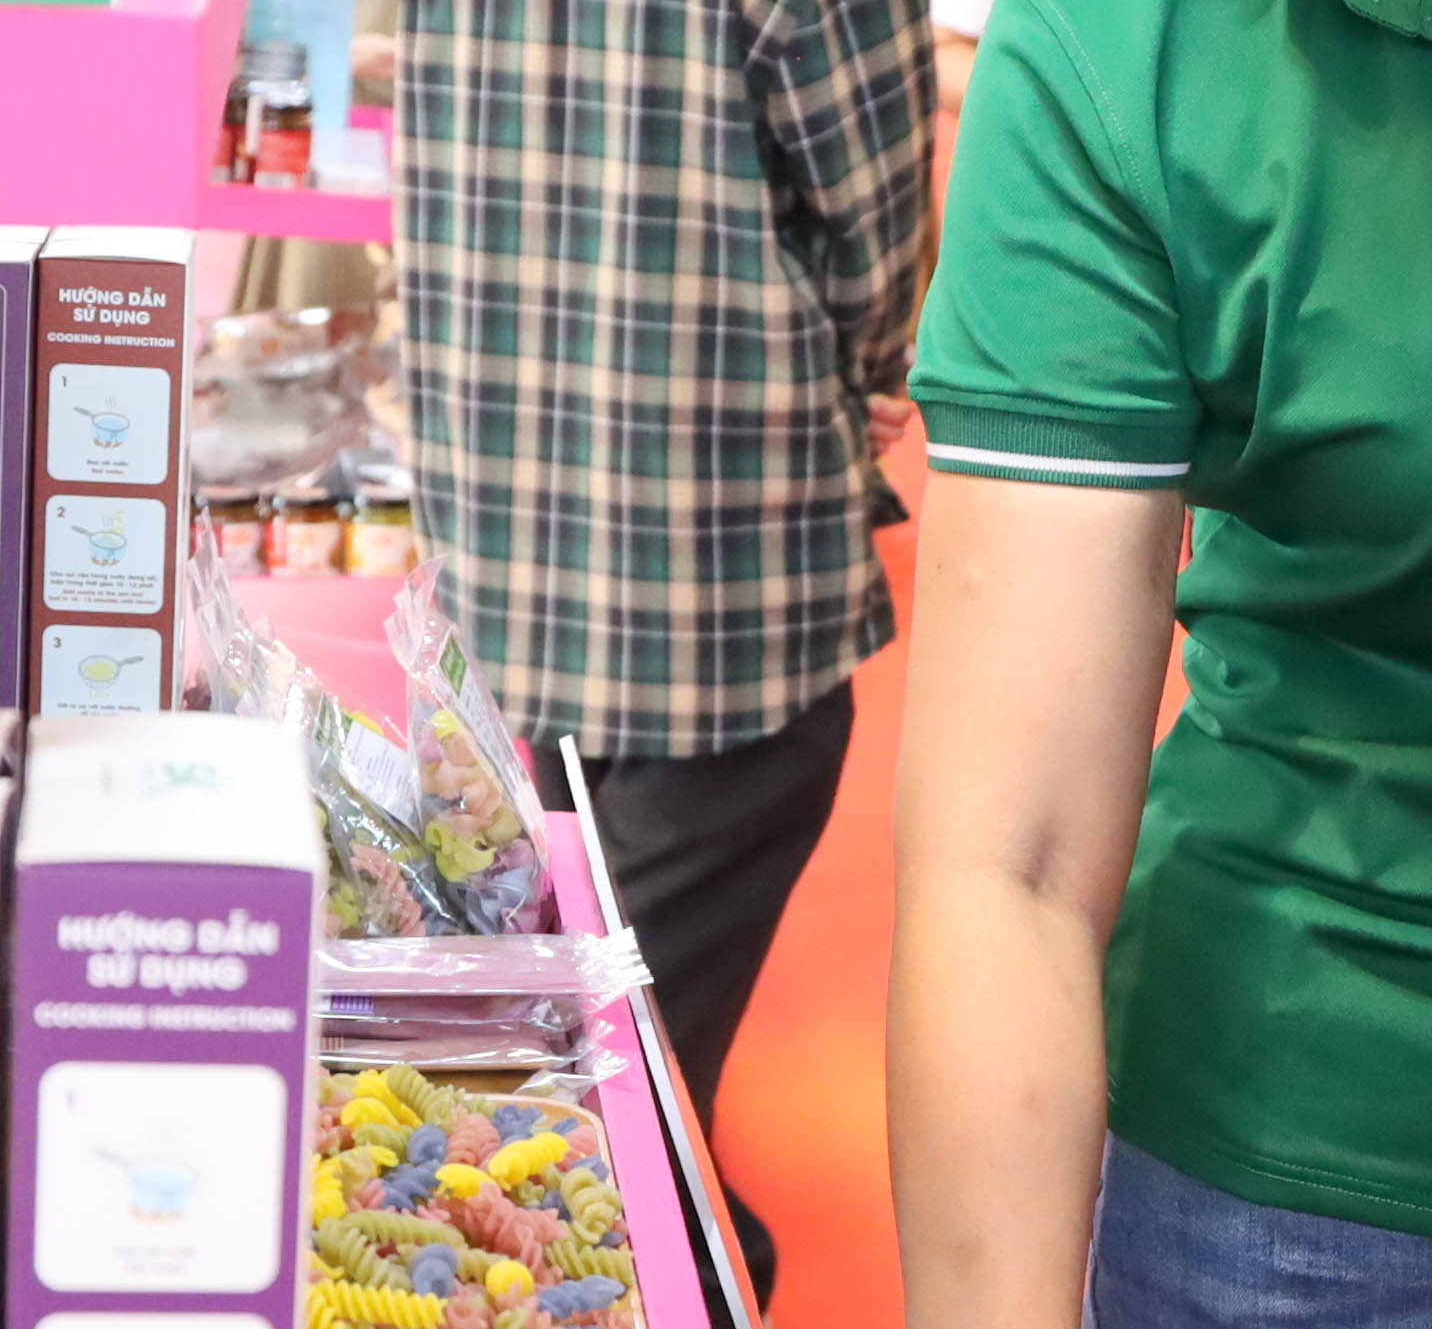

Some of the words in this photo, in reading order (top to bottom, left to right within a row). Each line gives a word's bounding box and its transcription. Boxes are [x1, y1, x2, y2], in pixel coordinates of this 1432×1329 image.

[58, 286, 124, 306] HƯỚNG
[128, 287, 167, 307] DẪN
[73, 304, 96, 322] SỬ
[99, 309, 151, 327] DỤNG
[47, 332, 102, 344] COOKING
[104, 335, 176, 348] INSTRUCTION
[61, 375, 67, 387] 1
[56, 506, 66, 518] 2
[53, 636, 62, 648] 3
[57, 913, 192, 951] HƯỚNG
[196, 908, 279, 955] DẪN
[140, 953, 248, 993] DỤNG
